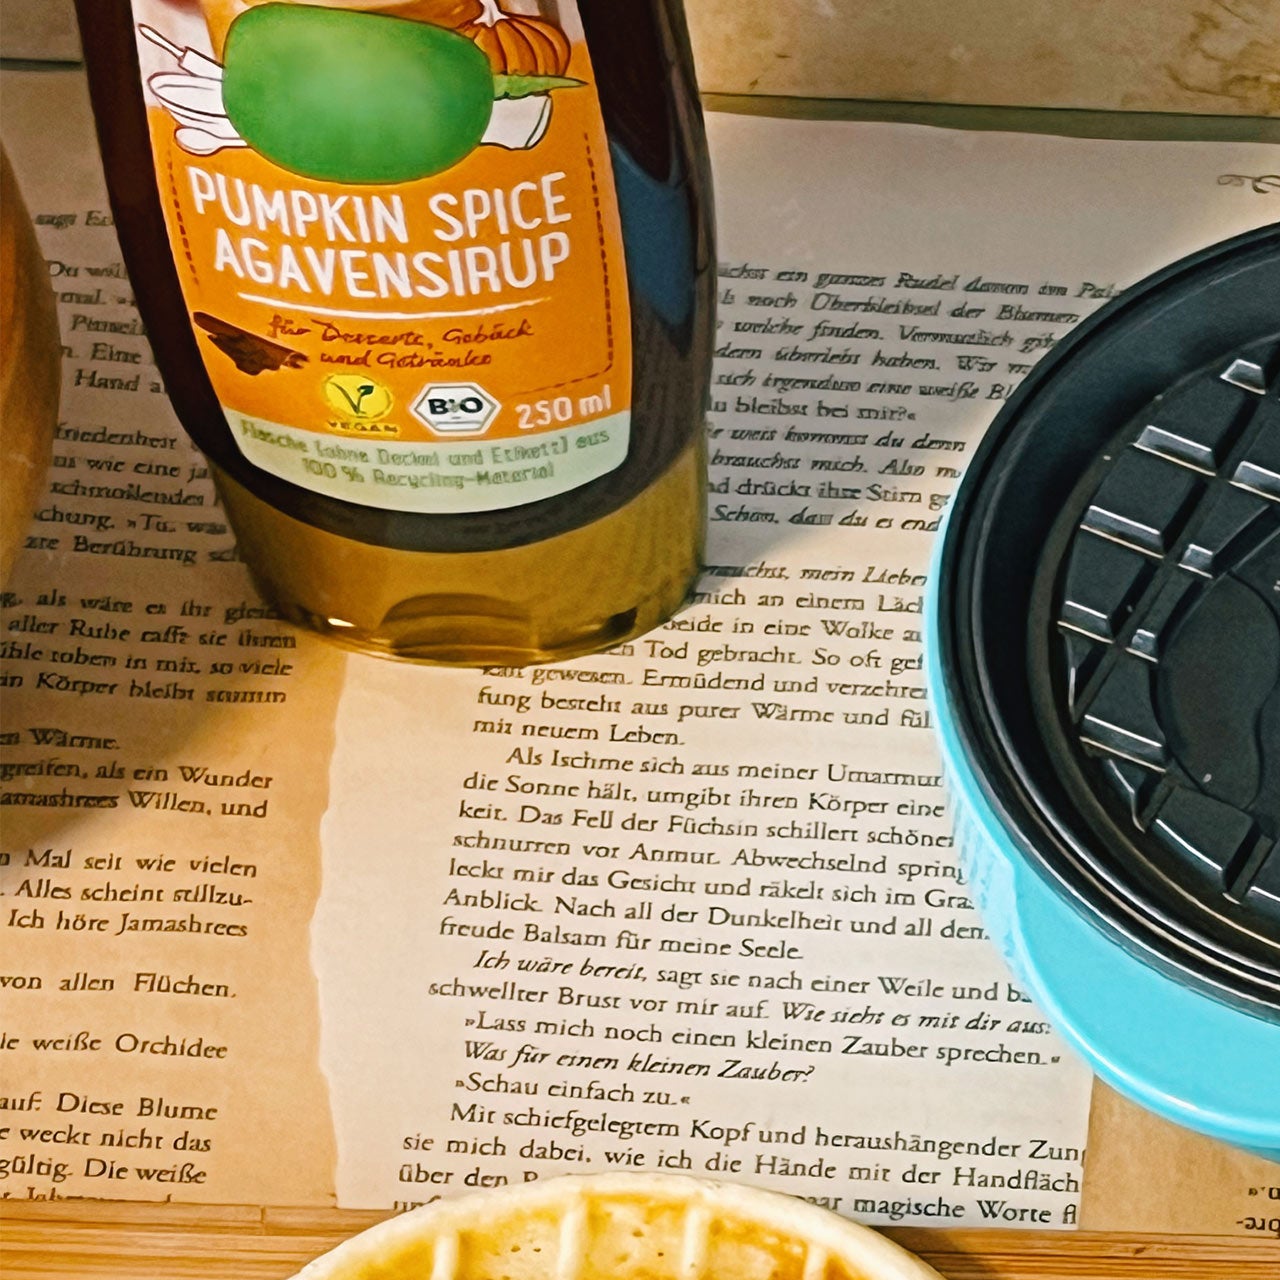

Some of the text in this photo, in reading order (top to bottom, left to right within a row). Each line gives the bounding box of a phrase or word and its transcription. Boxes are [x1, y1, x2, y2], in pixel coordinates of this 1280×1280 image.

[185, 165, 572, 244] PUMPKIN SPICE
[214, 227, 571, 298] AGAVENSIRUP
[320, 350, 371, 369] und
[515, 385, 613, 432] 250 ml
[328, 419, 399, 434] VEGAN
[302, 457, 338, 479] 100
[342, 464, 366, 484] %
[521, 725, 598, 740] neuem
[609, 724, 685, 745] Leben.
[459, 800, 507, 821] keit.
[517, 805, 563, 825] Das
[571, 809, 613, 829] Fell
[621, 813, 658, 832] der
[667, 815, 757, 836] Füchsin
[767, 820, 858, 842] schillert
[24, 849, 256, 878] Mal seit wie vielen
[15, 879, 252, 906] Alles scheint stillzu-
[8, 909, 44, 928] Ich
[56, 910, 109, 931] höre
[443, 888, 543, 912] Anblick.
[554, 896, 615, 917] Nach
[624, 902, 652, 920] all
[661, 904, 698, 923] der
[708, 907, 842, 931] Dunkelheit
[851, 916, 896, 935] und
[904, 918, 932, 936] all
[440, 916, 803, 959] freude Balsam für meine Seele.
[0, 973, 236, 998] von allen Flüchen.
[429, 977, 769, 1018] schwellter Brust vor mir auf.
[33, 1031, 227, 1058] weiße Orchidee
[465, 1011, 1060, 1066] »Lass mich noch einen kleinen Zauber sprechen.«
[465, 1041, 815, 1082] Was für einen kleinen Zauber?
[456, 1072, 538, 1095] »Schau
[548, 1080, 634, 1102] einfach
[56, 1093, 124, 1115] Diese
[137, 1097, 217, 1120] Blume
[20, 1124, 211, 1152] weckt nicht das
[451, 1103, 496, 1124] Mit
[503, 1105, 680, 1138] schiefgelegtem
[690, 1120, 755, 1146] Kopf
[759, 1126, 806, 1145] und
[815, 1127, 1021, 1160] heraushängender
[84, 1158, 128, 1179] Die
[135, 1163, 206, 1184] weiße
[403, 1134, 434, 1151] sie
[446, 1136, 506, 1156] mich
[519, 1139, 591, 1163] dabei,
[605, 1148, 645, 1166] wie
[657, 1149, 692, 1169] ich
[705, 1152, 741, 1173] die
[755, 1155, 836, 1179] Hände
[849, 1164, 890, 1182] mit
[902, 1164, 941, 1184] der
[850, 1196, 1051, 1223] magische Worte
